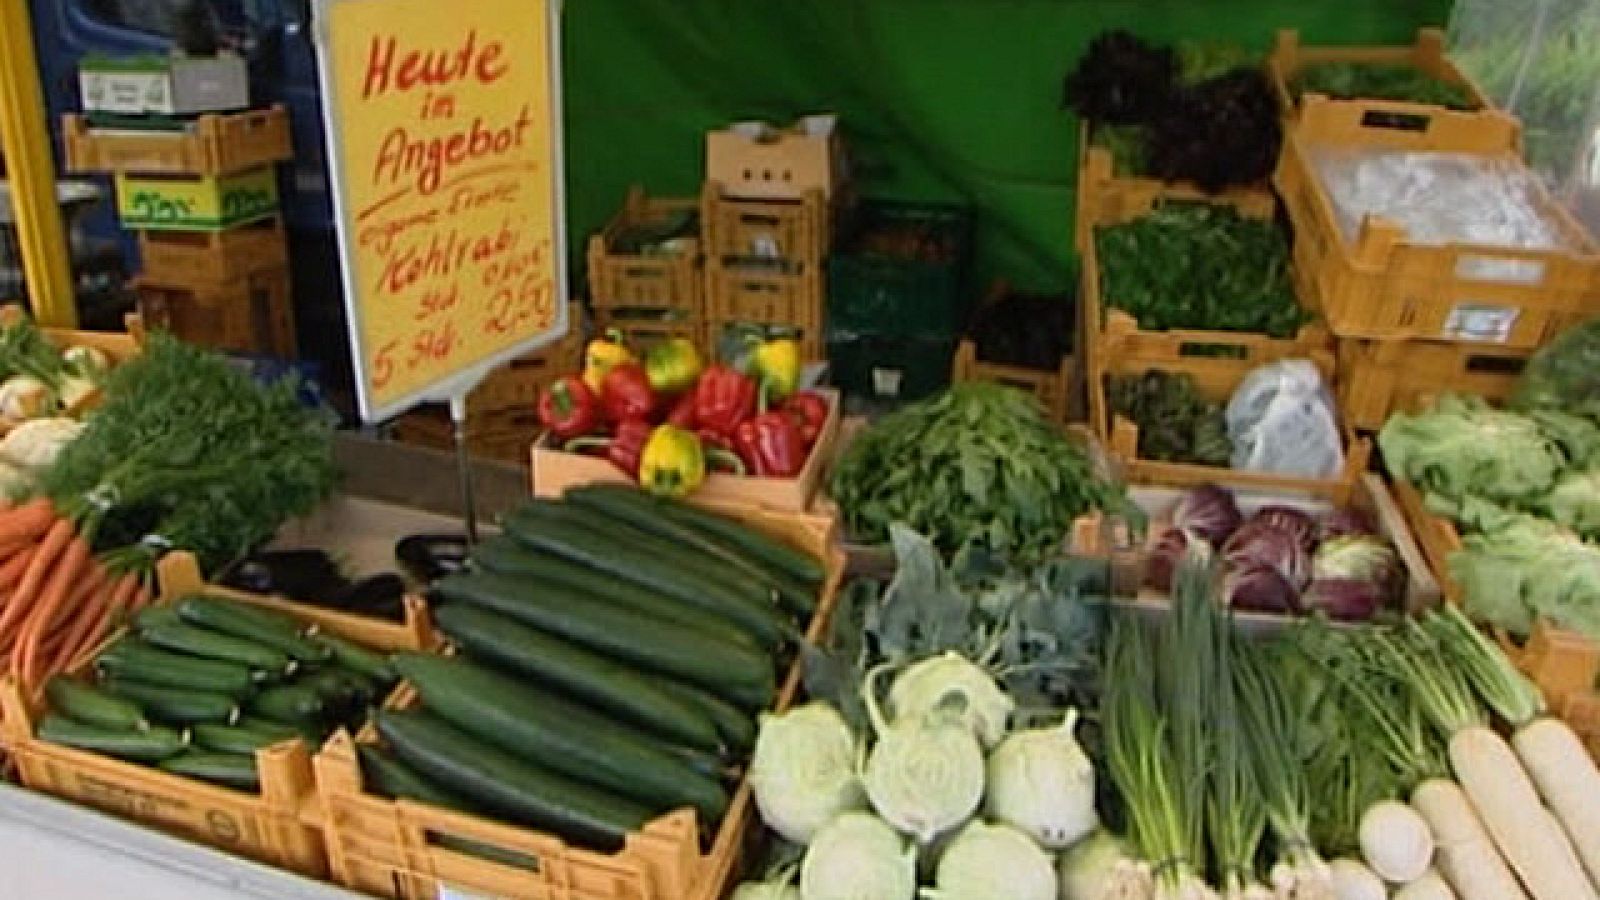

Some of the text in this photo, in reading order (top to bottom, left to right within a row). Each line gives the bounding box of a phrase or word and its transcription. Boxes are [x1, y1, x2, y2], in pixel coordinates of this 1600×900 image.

[363, 30, 510, 99] Heute
[420, 92, 454, 120] in
[374, 104, 532, 195] Angebot
[376, 213, 528, 293] Kohlrabi
[373, 338, 398, 389] 5
